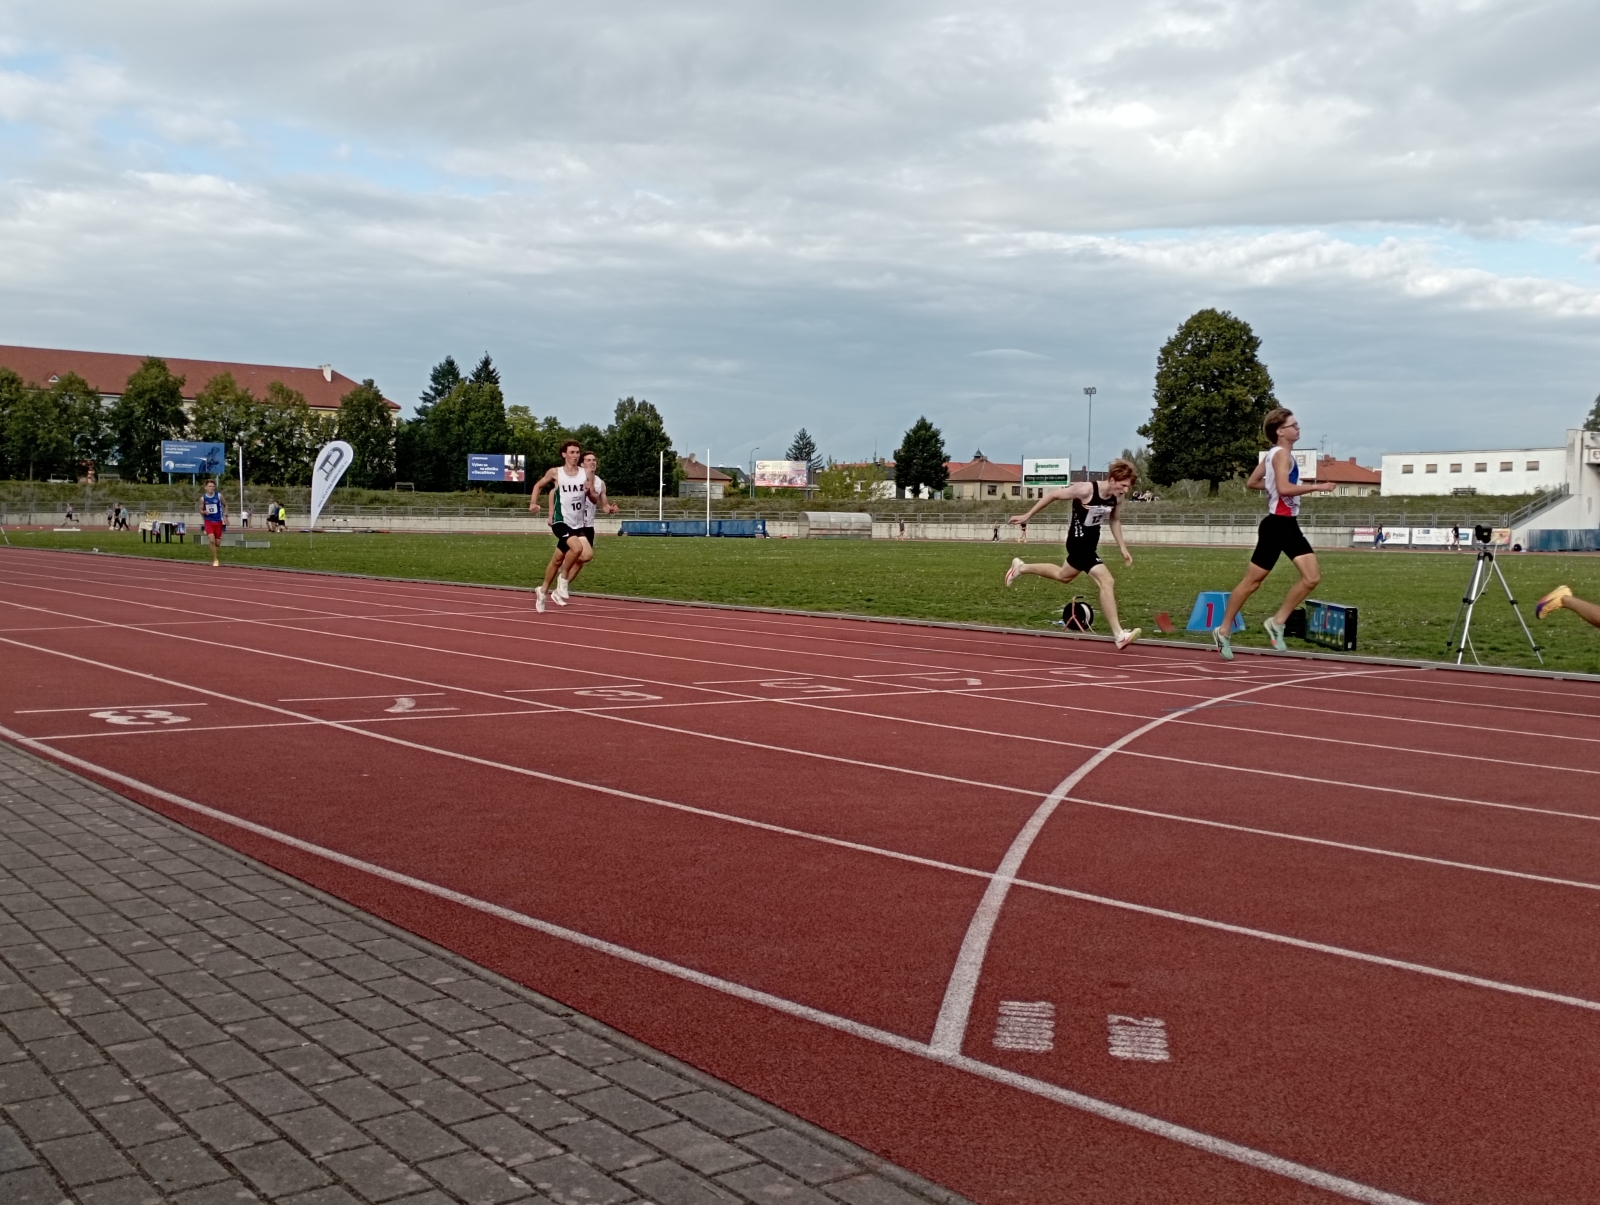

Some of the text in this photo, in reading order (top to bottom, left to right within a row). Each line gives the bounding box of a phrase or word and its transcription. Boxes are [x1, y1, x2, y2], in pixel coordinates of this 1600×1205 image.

[562, 484, 584, 492] LIAZ
[571, 502, 582, 511] 10
[1206, 603, 1214, 628] 1
